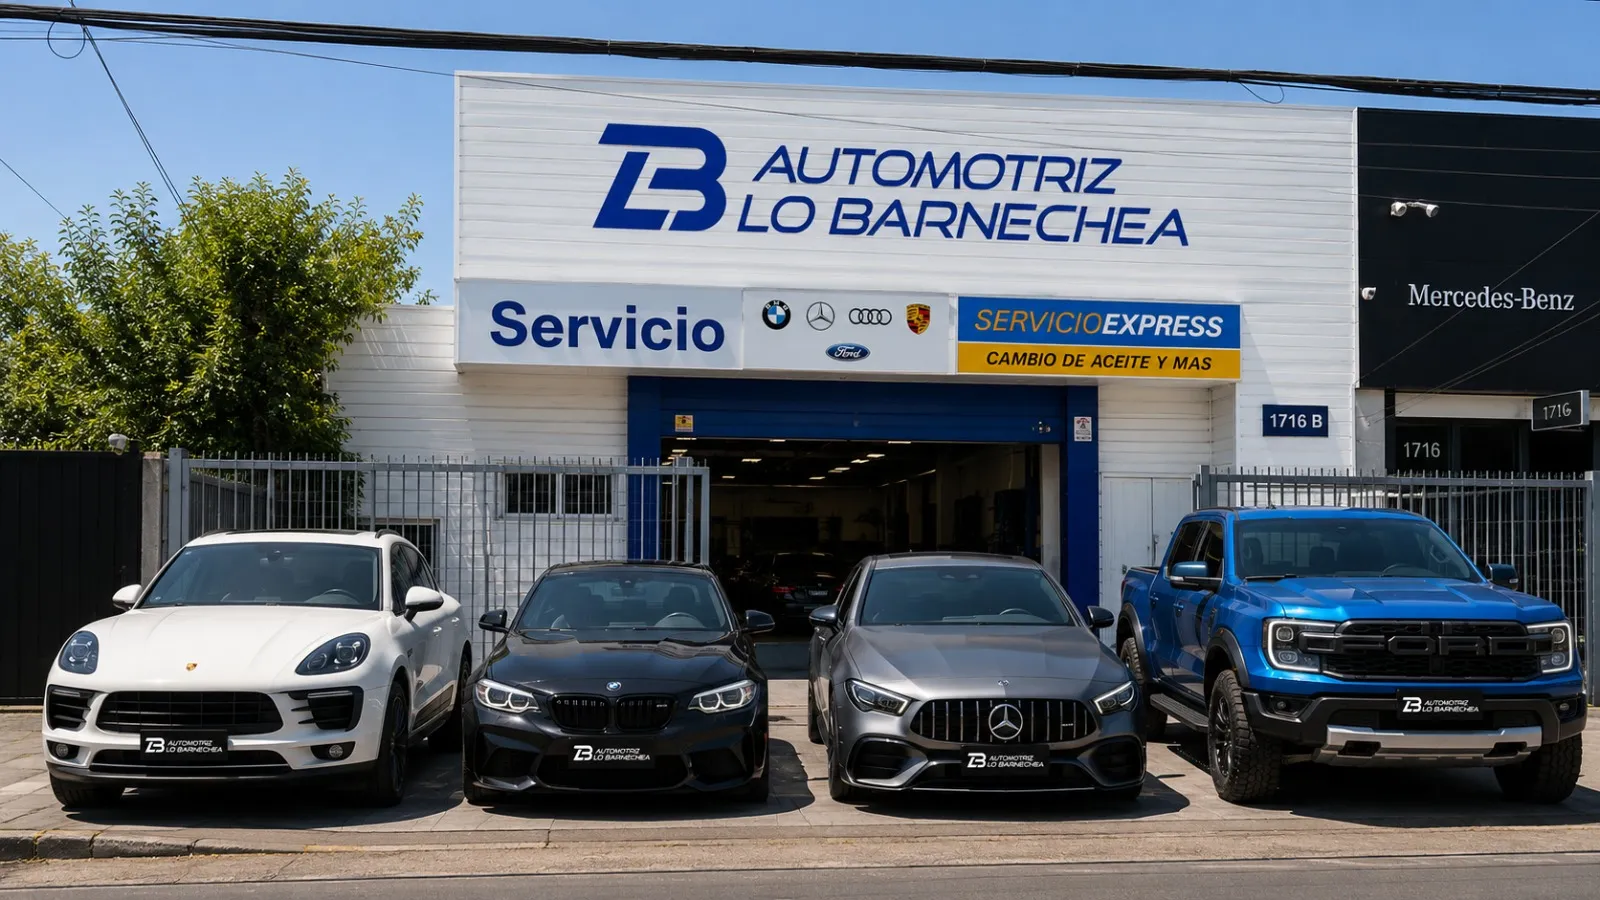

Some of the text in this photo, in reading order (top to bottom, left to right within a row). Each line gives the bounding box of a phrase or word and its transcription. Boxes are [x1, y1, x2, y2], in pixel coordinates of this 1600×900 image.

[753, 145, 1122, 195] AUTOMOTRIZ
[737, 195, 1190, 247] LO BARNECHEA
[1408, 283, 1575, 311] Mercedes-Benz
[491, 299, 725, 353] Servicio
[986, 351, 1212, 371] CAMBIO DE ACEITE Y MAS
[1269, 413, 1323, 428] 1716 B
[1403, 442, 1441, 458] 1716
